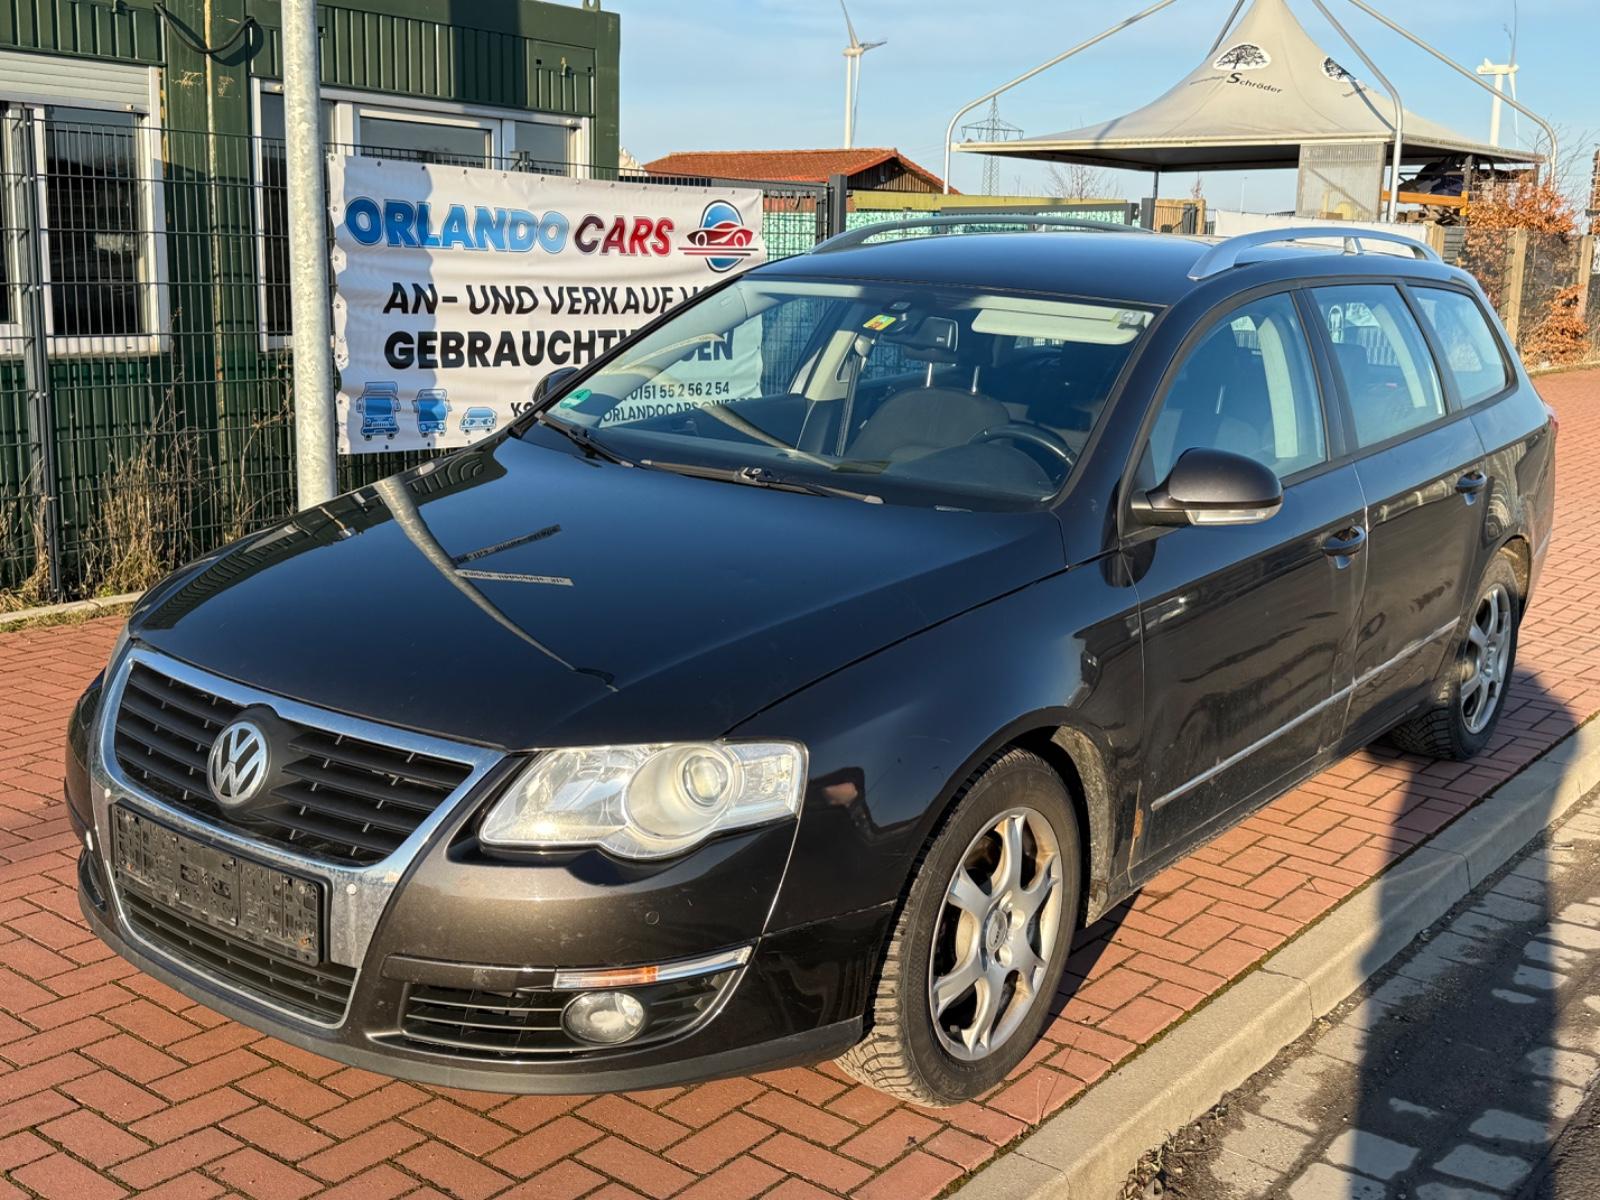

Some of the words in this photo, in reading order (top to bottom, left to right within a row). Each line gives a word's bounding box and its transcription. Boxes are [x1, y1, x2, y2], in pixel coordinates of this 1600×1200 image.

[1226, 72, 1284, 94] Schröder
[344, 196, 570, 255] ORLANDO
[573, 213, 675, 257] CARS
[382, 282, 458, 315] AN-
[465, 284, 540, 315] UND
[543, 286, 674, 315] VERKAUF
[384, 329, 733, 370] GEBRAUCHTEN
[659, 384, 675, 399] 55
[677, 383, 685, 398] 2
[688, 382, 703, 397] 56
[705, 382, 713, 396] 2
[715, 381, 729, 396] 54
